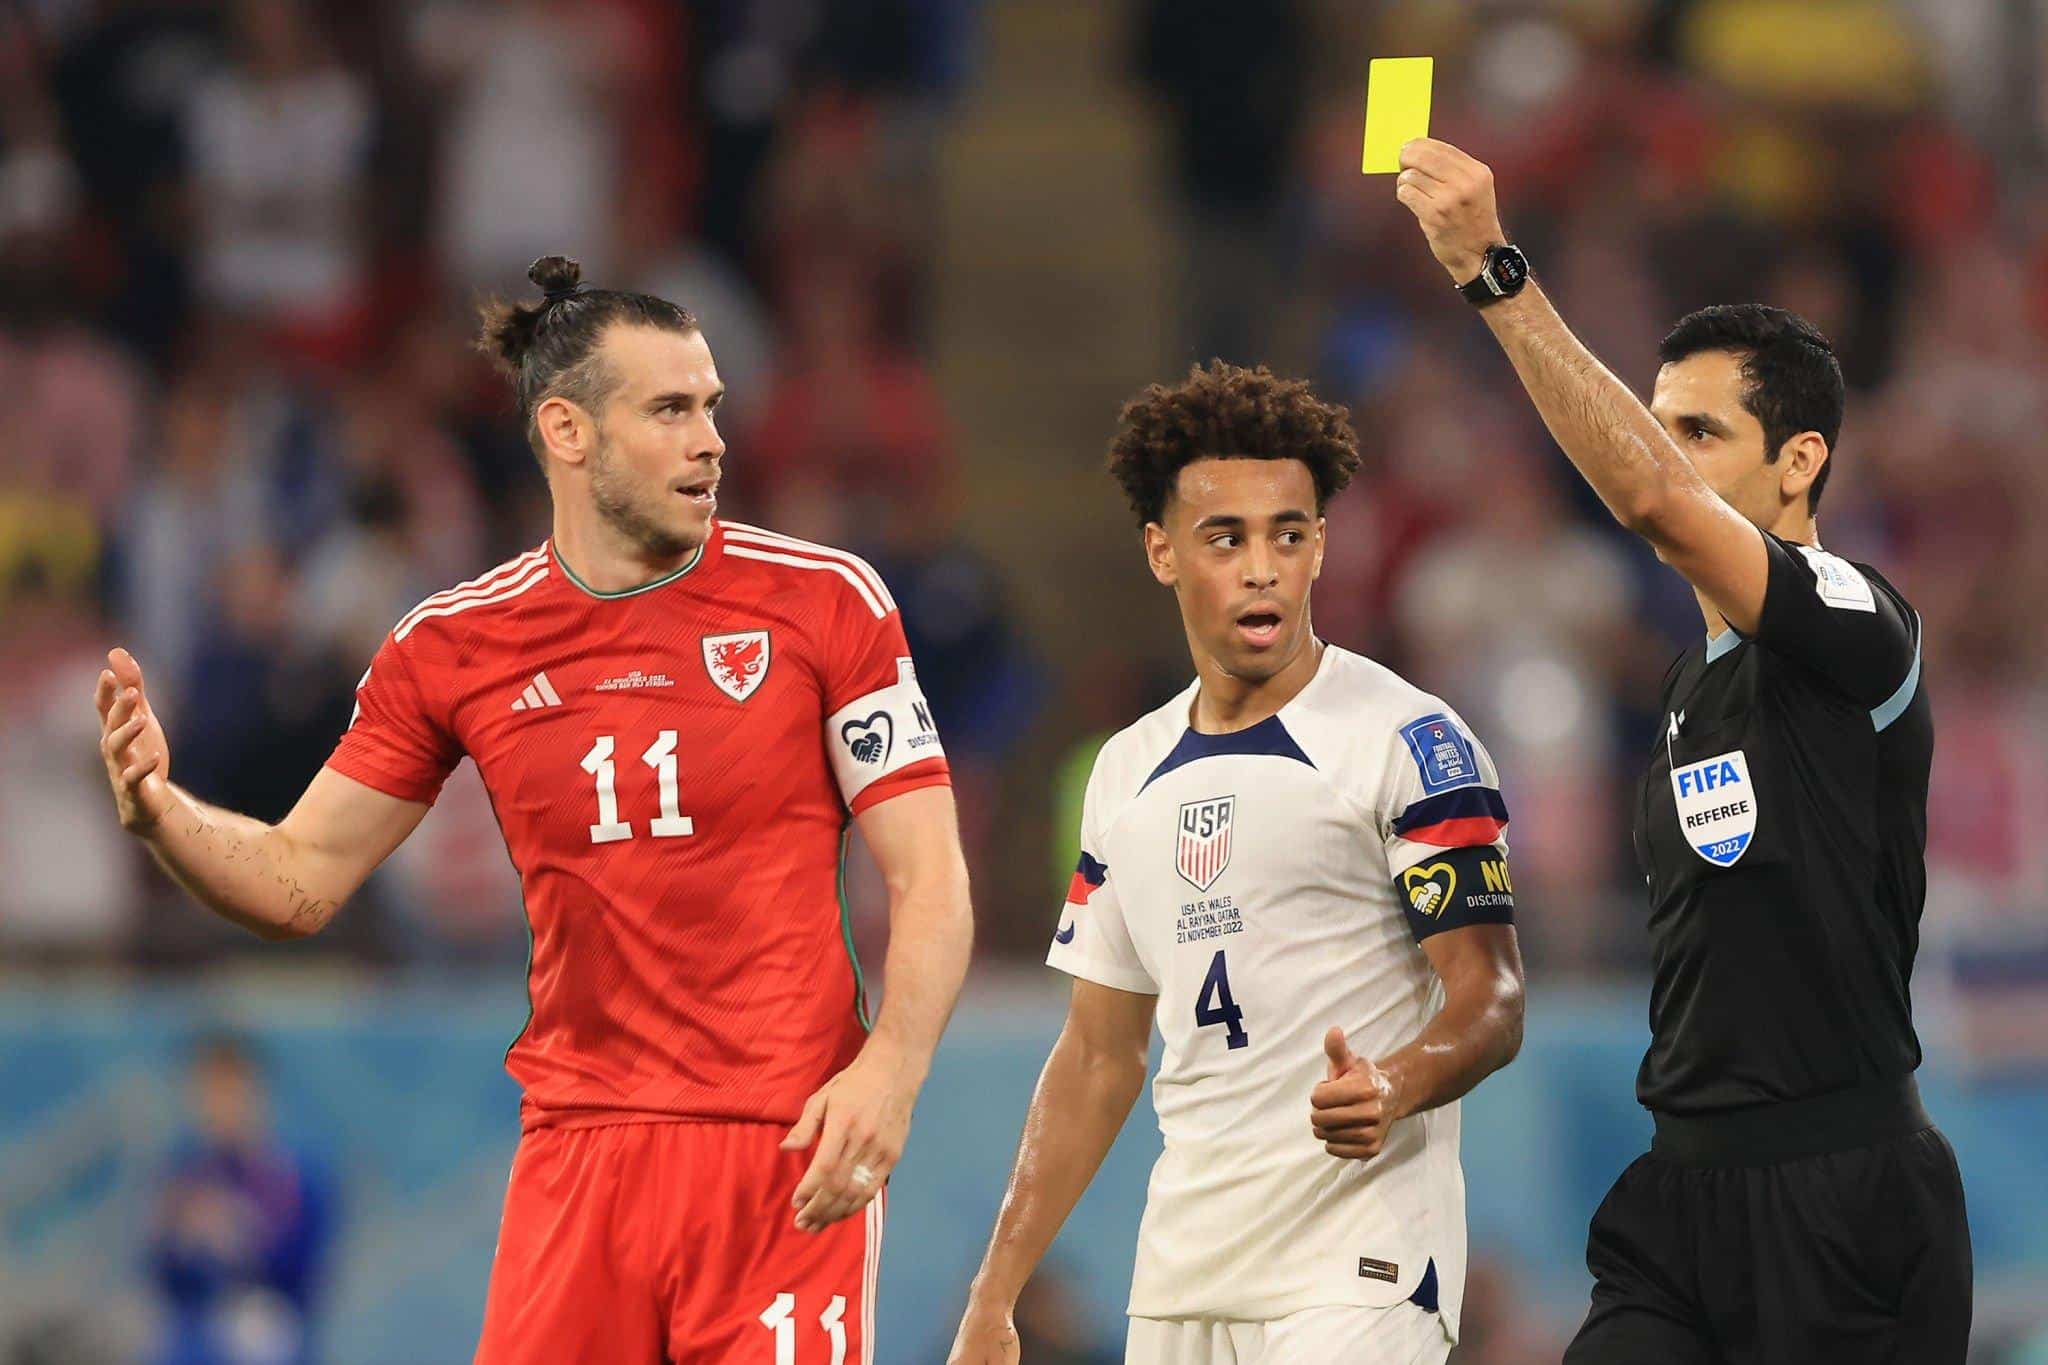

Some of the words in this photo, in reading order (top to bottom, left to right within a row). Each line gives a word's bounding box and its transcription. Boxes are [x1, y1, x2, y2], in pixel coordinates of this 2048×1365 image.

[579, 730, 694, 843] 11
[1678, 761, 1741, 798] FIFA
[1184, 801, 1231, 838] USA
[1686, 800, 1750, 829] REFEREE
[1710, 840, 1741, 858] 2022
[1177, 919, 1188, 930] AL
[1218, 908, 1240, 923] QATAR
[1181, 904, 1196, 916] USA
[1208, 896, 1231, 910] WALES
[1177, 932, 1186, 944] 21
[1187, 925, 1222, 942] NOVEMBER
[1223, 921, 1243, 935] 2022
[1195, 950, 1248, 1050] 4
[759, 1293, 847, 1365] 11
